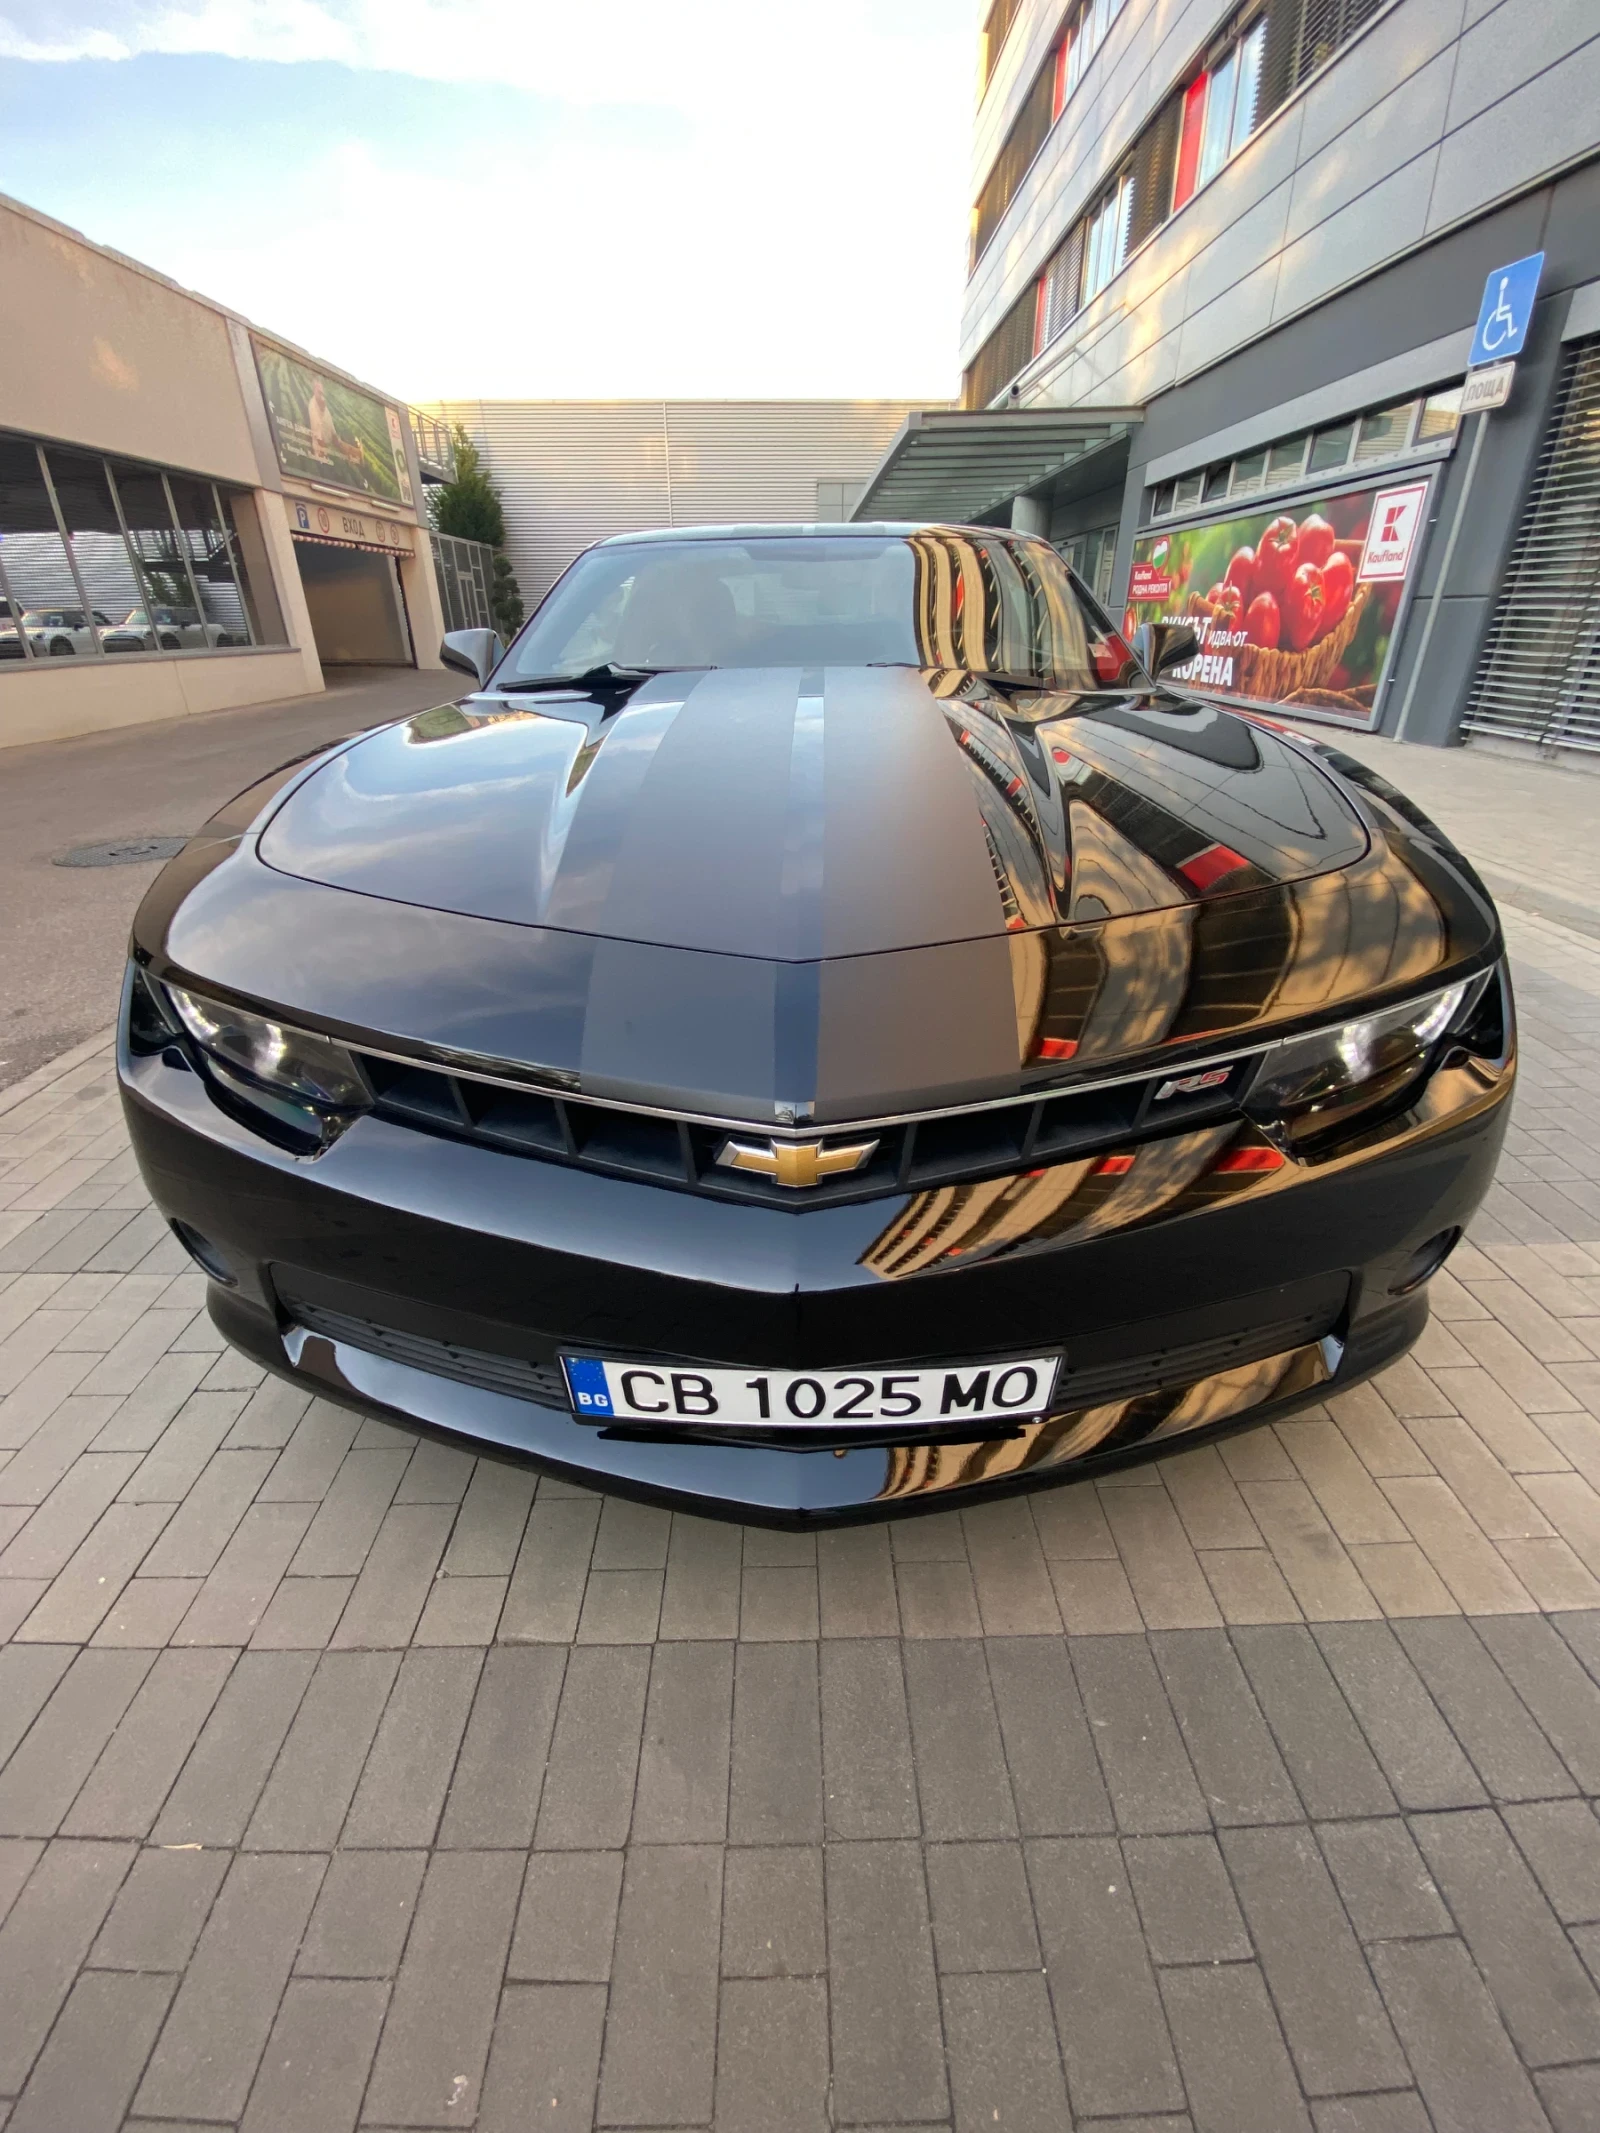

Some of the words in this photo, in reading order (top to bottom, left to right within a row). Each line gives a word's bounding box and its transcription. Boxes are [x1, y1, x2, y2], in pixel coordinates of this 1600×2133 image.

[1466, 377, 1504, 401] ПОЩА
[342, 516, 366, 538] ВХОД
[1367, 548, 1406, 564] Kaufland
[1134, 570, 1153, 580] Kaufland
[1132, 584, 1148, 596] РОДНА
[1207, 630, 1232, 648] ИДВА
[1233, 631, 1248, 647] ОТ
[1153, 1065, 1234, 1100] RS
[577, 1391, 609, 1407] BG
[620, 1369, 719, 1416] CB
[745, 1375, 922, 1419] 1025
[939, 1365, 1048, 1415] MO
